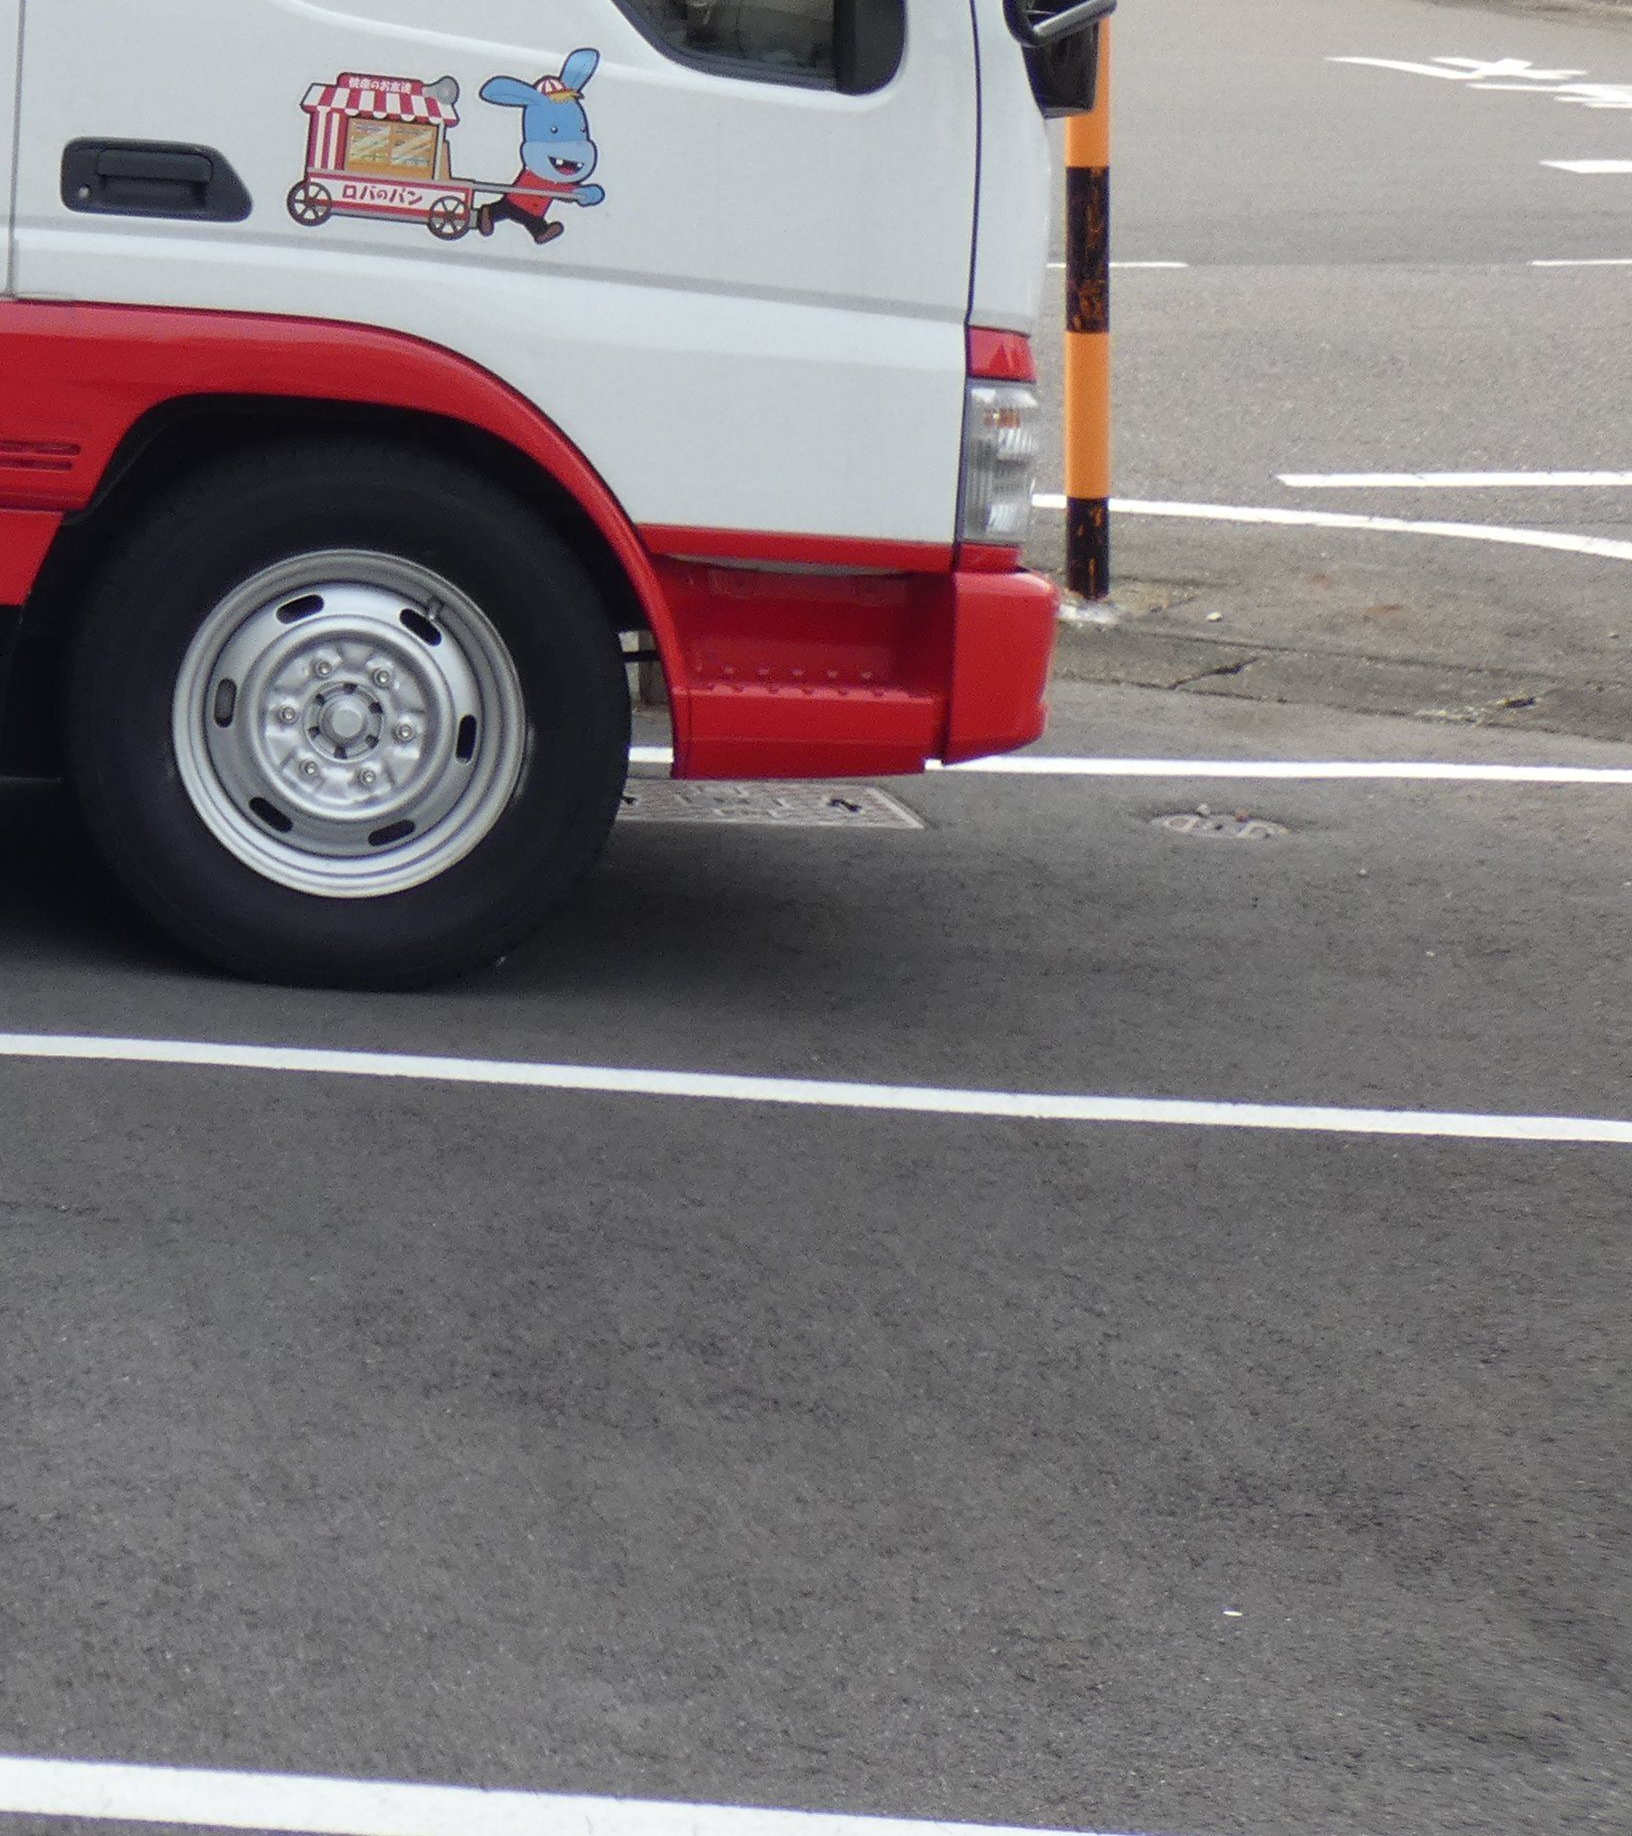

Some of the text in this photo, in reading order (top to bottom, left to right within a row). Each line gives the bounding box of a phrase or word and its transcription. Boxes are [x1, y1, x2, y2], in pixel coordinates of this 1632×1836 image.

[342, 184, 424, 206] ロバのパン
